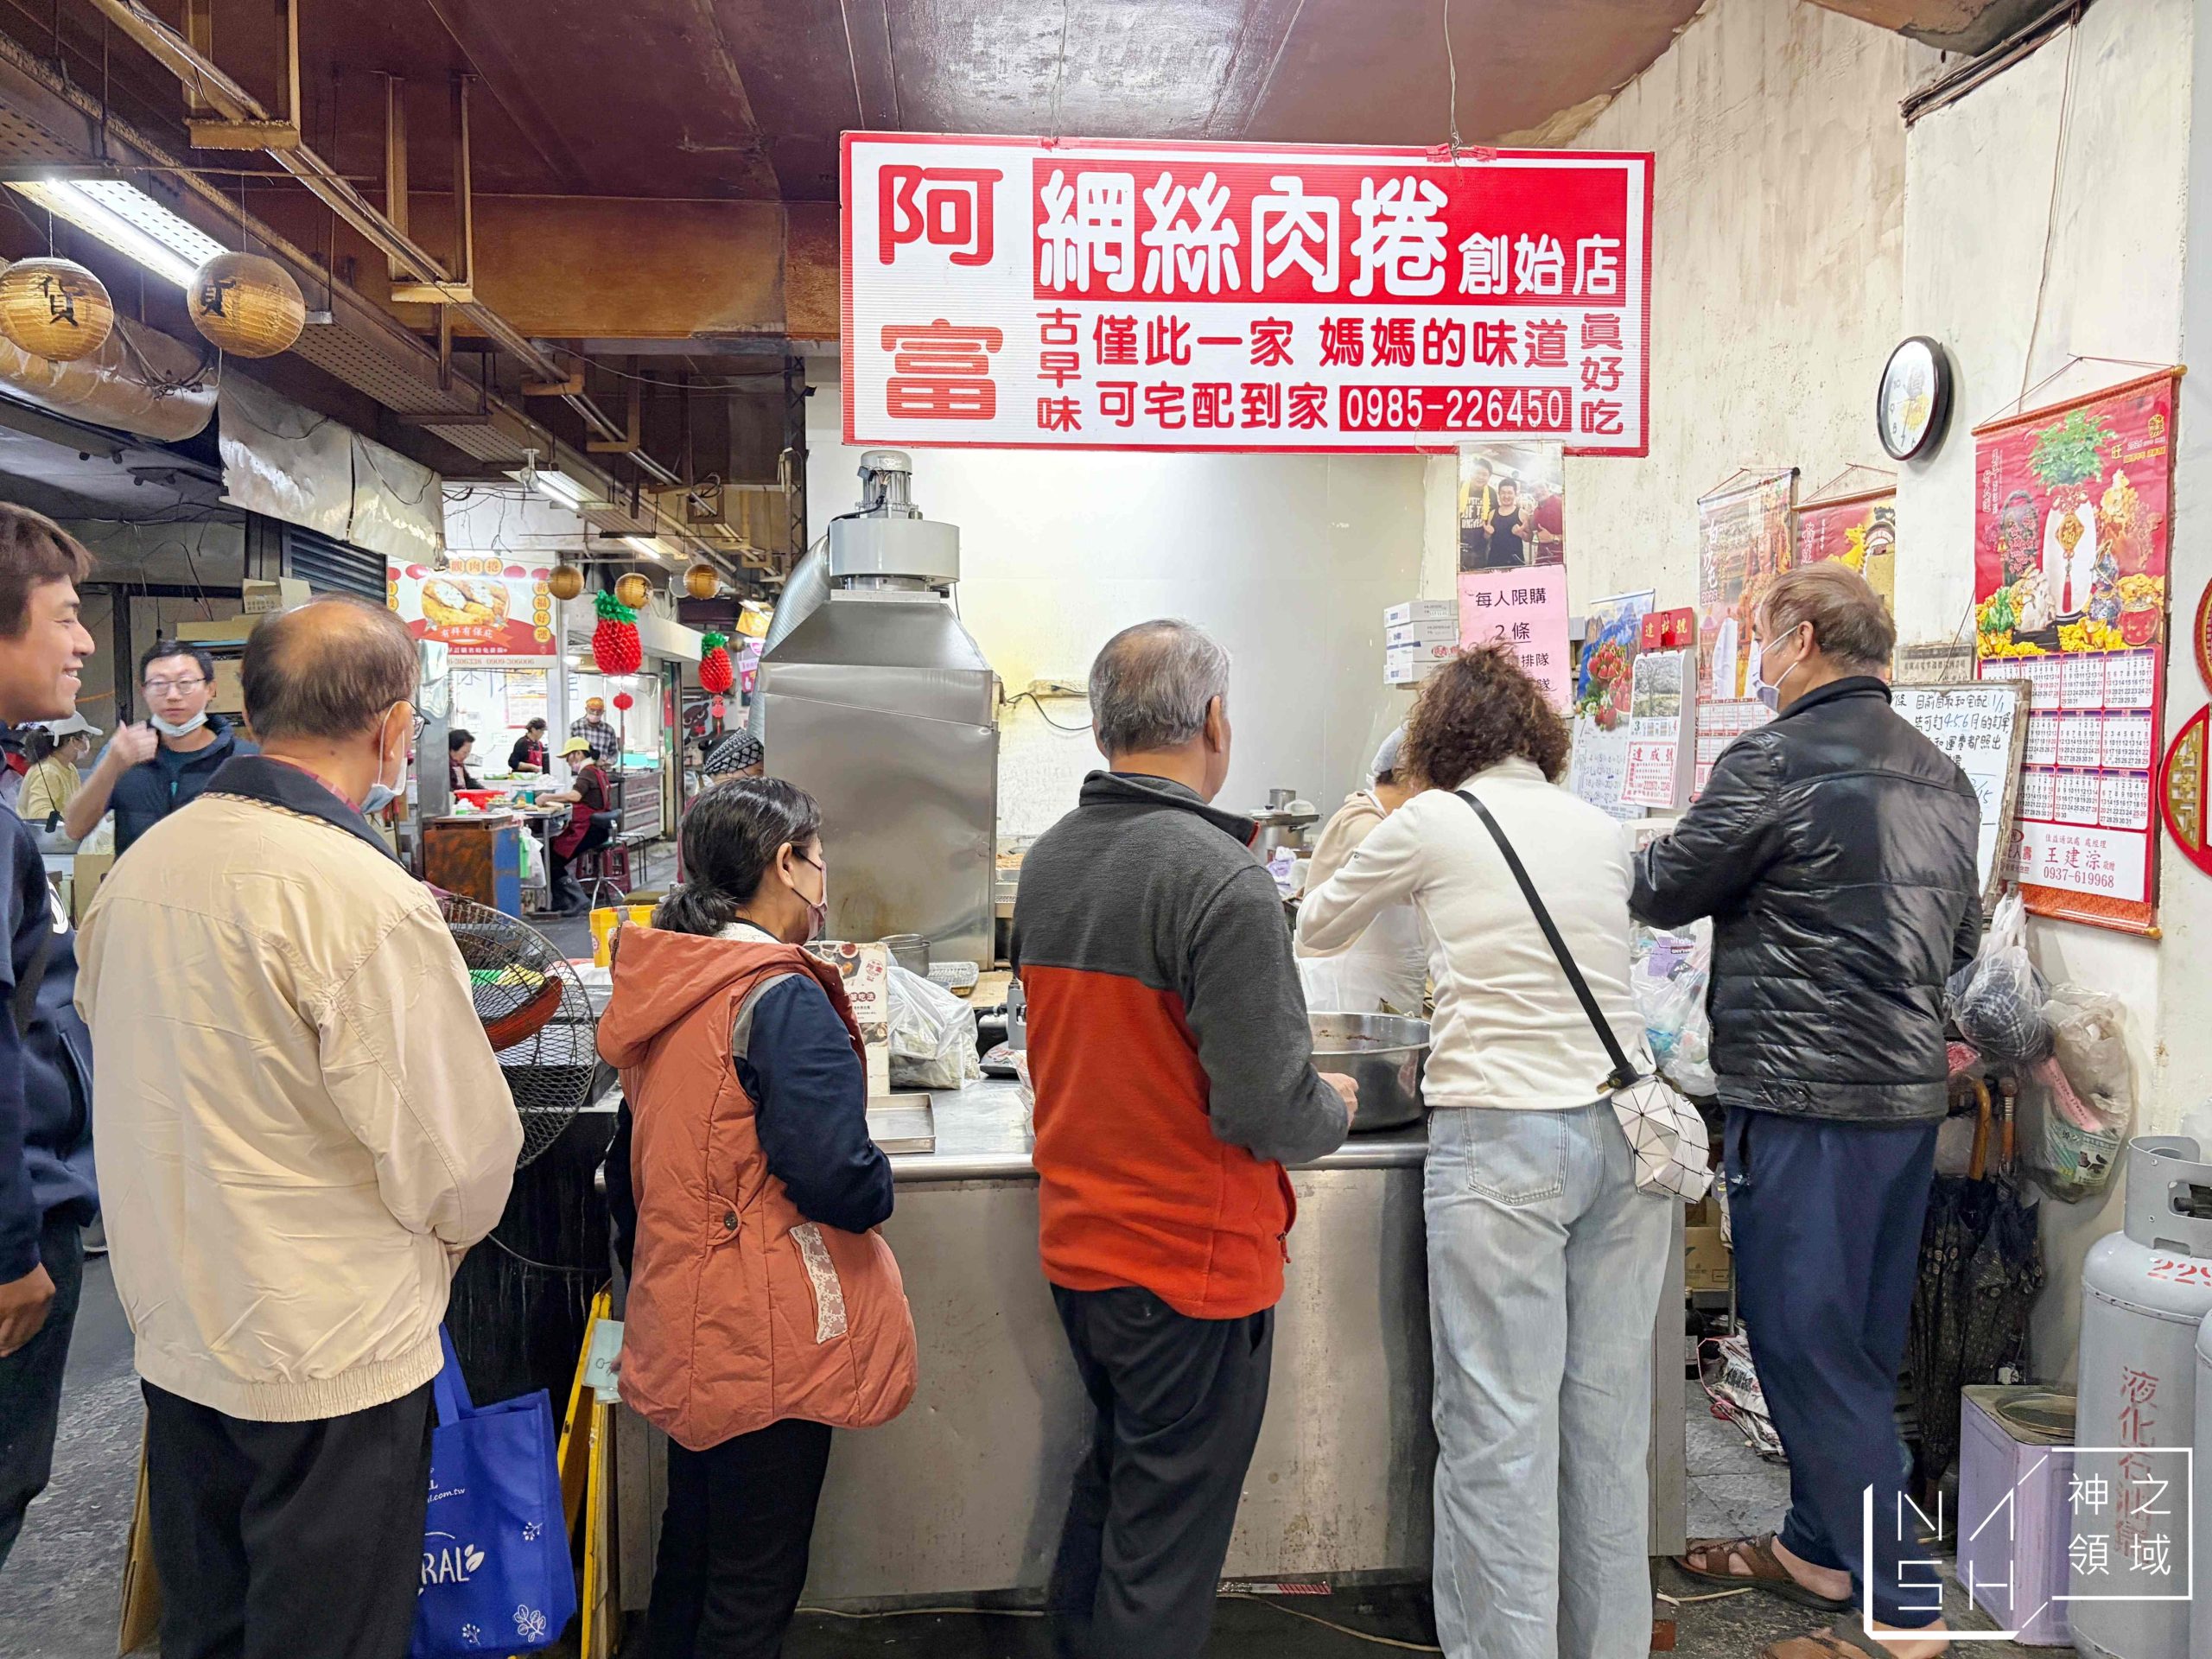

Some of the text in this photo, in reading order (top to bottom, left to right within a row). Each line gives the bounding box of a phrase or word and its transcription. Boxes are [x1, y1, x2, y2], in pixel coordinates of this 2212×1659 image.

[1038, 168, 1620, 297] 網絲肉捲 創始店
[879, 164, 1003, 420] 阿富
[1092, 314, 1568, 368] 僅此一家 媽媽的味道
[1036, 308, 1082, 432] 古早味
[1096, 380, 1562, 430] 可宅配到家 0985-226450
[1475, 588, 1547, 607] 每人限購
[1929, 734, 2001, 750] 和運費都照出
[2044, 866, 2114, 888] 0937-619968
[421, 1547, 470, 1585] RAL
